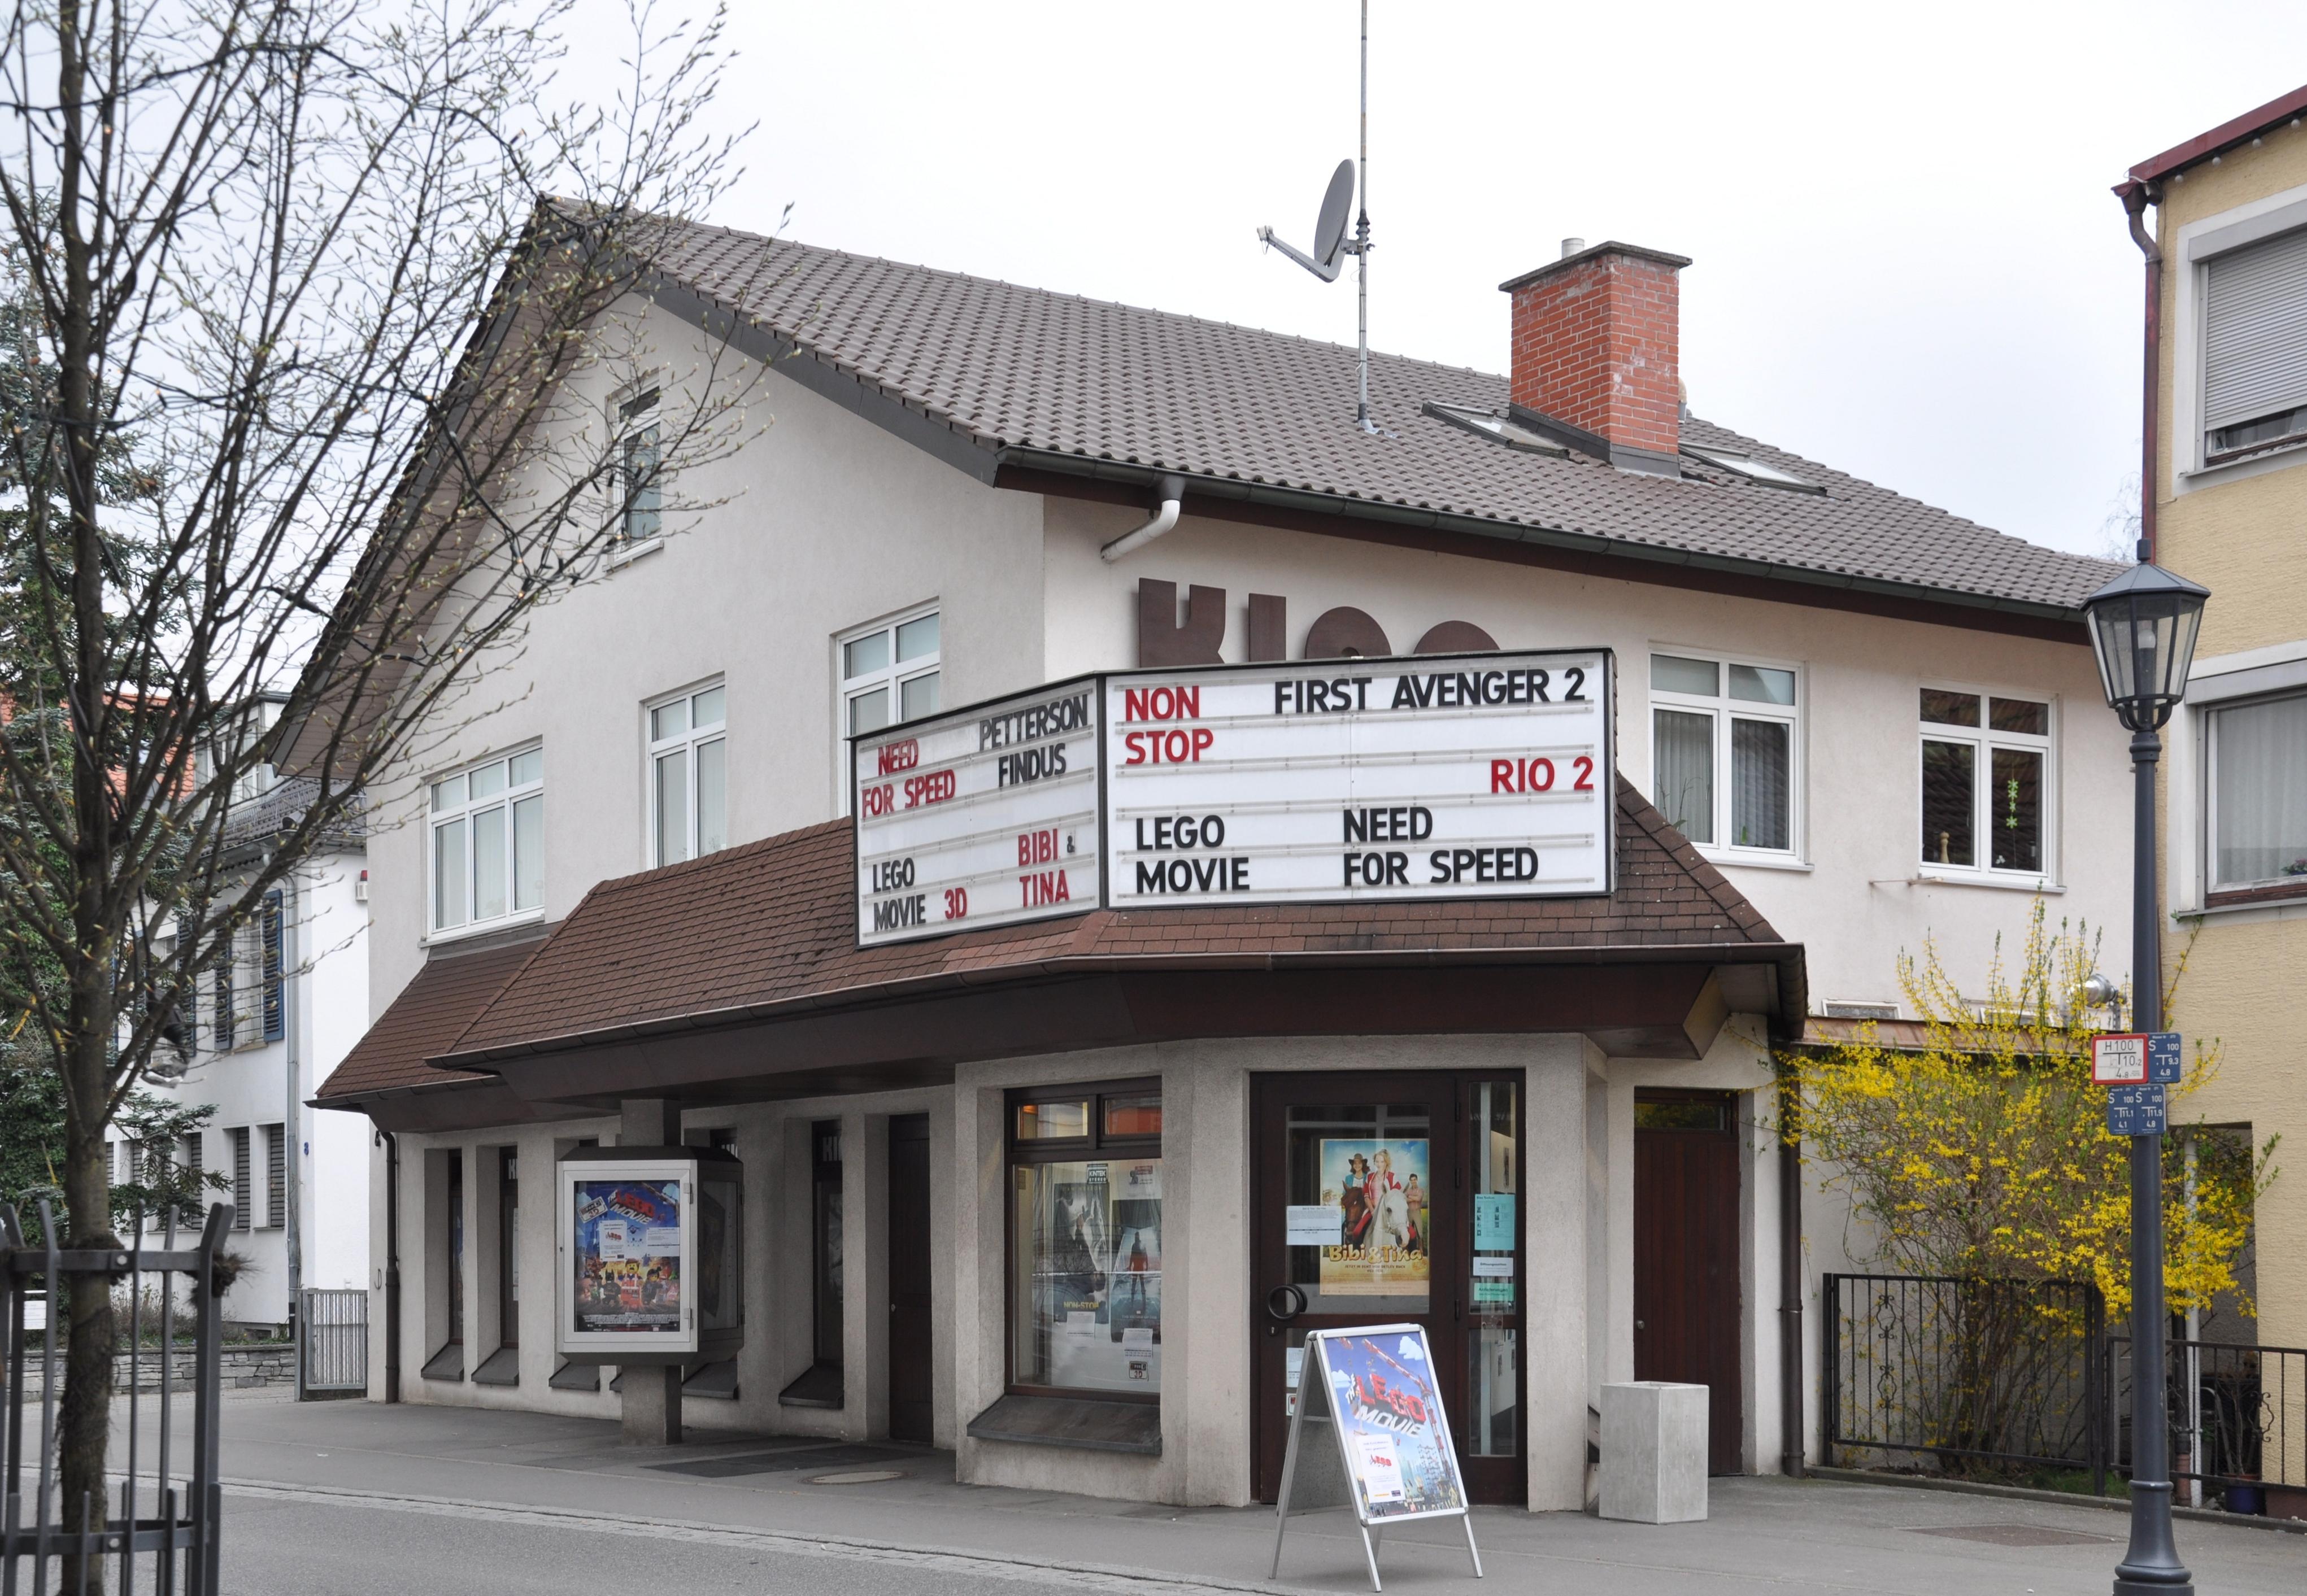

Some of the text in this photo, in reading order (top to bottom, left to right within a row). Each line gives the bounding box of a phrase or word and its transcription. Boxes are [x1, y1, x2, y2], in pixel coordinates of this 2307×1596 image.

[1138, 578, 1501, 668] KI
[1126, 685, 1199, 721] NON
[1275, 667, 1585, 714] FIRST AVENGER 2
[980, 695, 1087, 751] PETTERSON
[878, 738, 918, 776] NEED
[1126, 728, 1213, 764] STOP
[999, 743, 1066, 787] FINDUS
[1491, 756, 1594, 793] RIO 2
[863, 769, 956, 818] FOR SPEED
[1137, 814, 1225, 851] LEGO
[1344, 806, 1433, 843] NEED
[1018, 828, 1076, 866] BIBI &
[873, 858, 915, 893] LEGO
[1137, 857, 1250, 894] MOVIE
[1344, 848, 1538, 887] FOR SPEED
[1020, 870, 1069, 908] TINA
[874, 887, 967, 932] MOVIE 3D
[2149, 1040, 2156, 1051] S
[2108, 1093, 2115, 1104] S
[2136, 1092, 2142, 1103] S
[610, 1203, 652, 1224] MOVIE
[616, 1191, 655, 1217] LEGO
[1329, 1244, 1422, 1264] Bibi & Tina
[1356, 1373, 1426, 1421] LEGO
[1355, 1405, 1425, 1438] MOVIE
